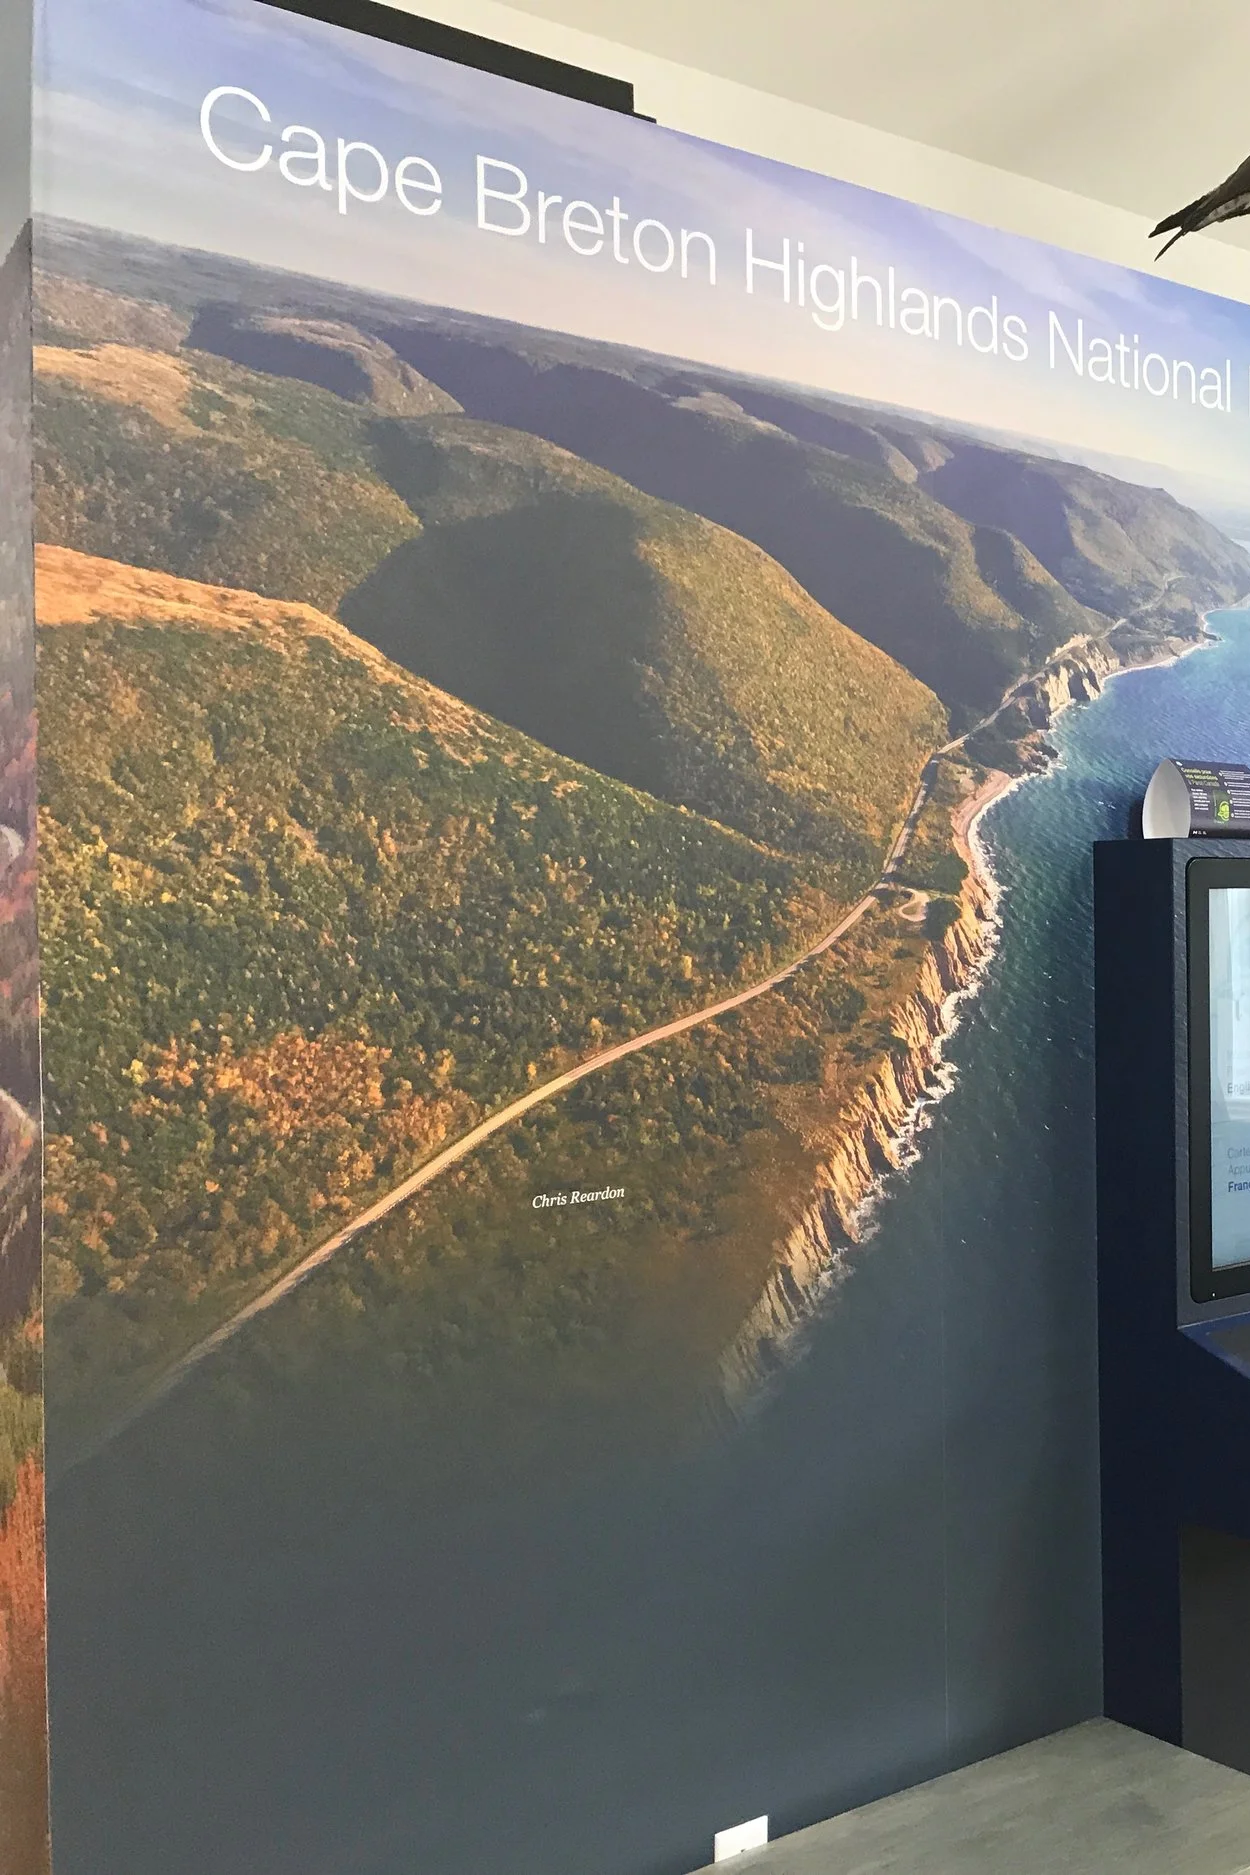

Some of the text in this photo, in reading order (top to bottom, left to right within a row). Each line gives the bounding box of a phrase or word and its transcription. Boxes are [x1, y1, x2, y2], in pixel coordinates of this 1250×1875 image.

[199, 86, 443, 214] Cape
[477, 154, 717, 285] Breton
[745, 227, 1029, 362] Highlands
[1048, 310, 1232, 414] National
[532, 1185, 625, 1209] Chris Reardon
